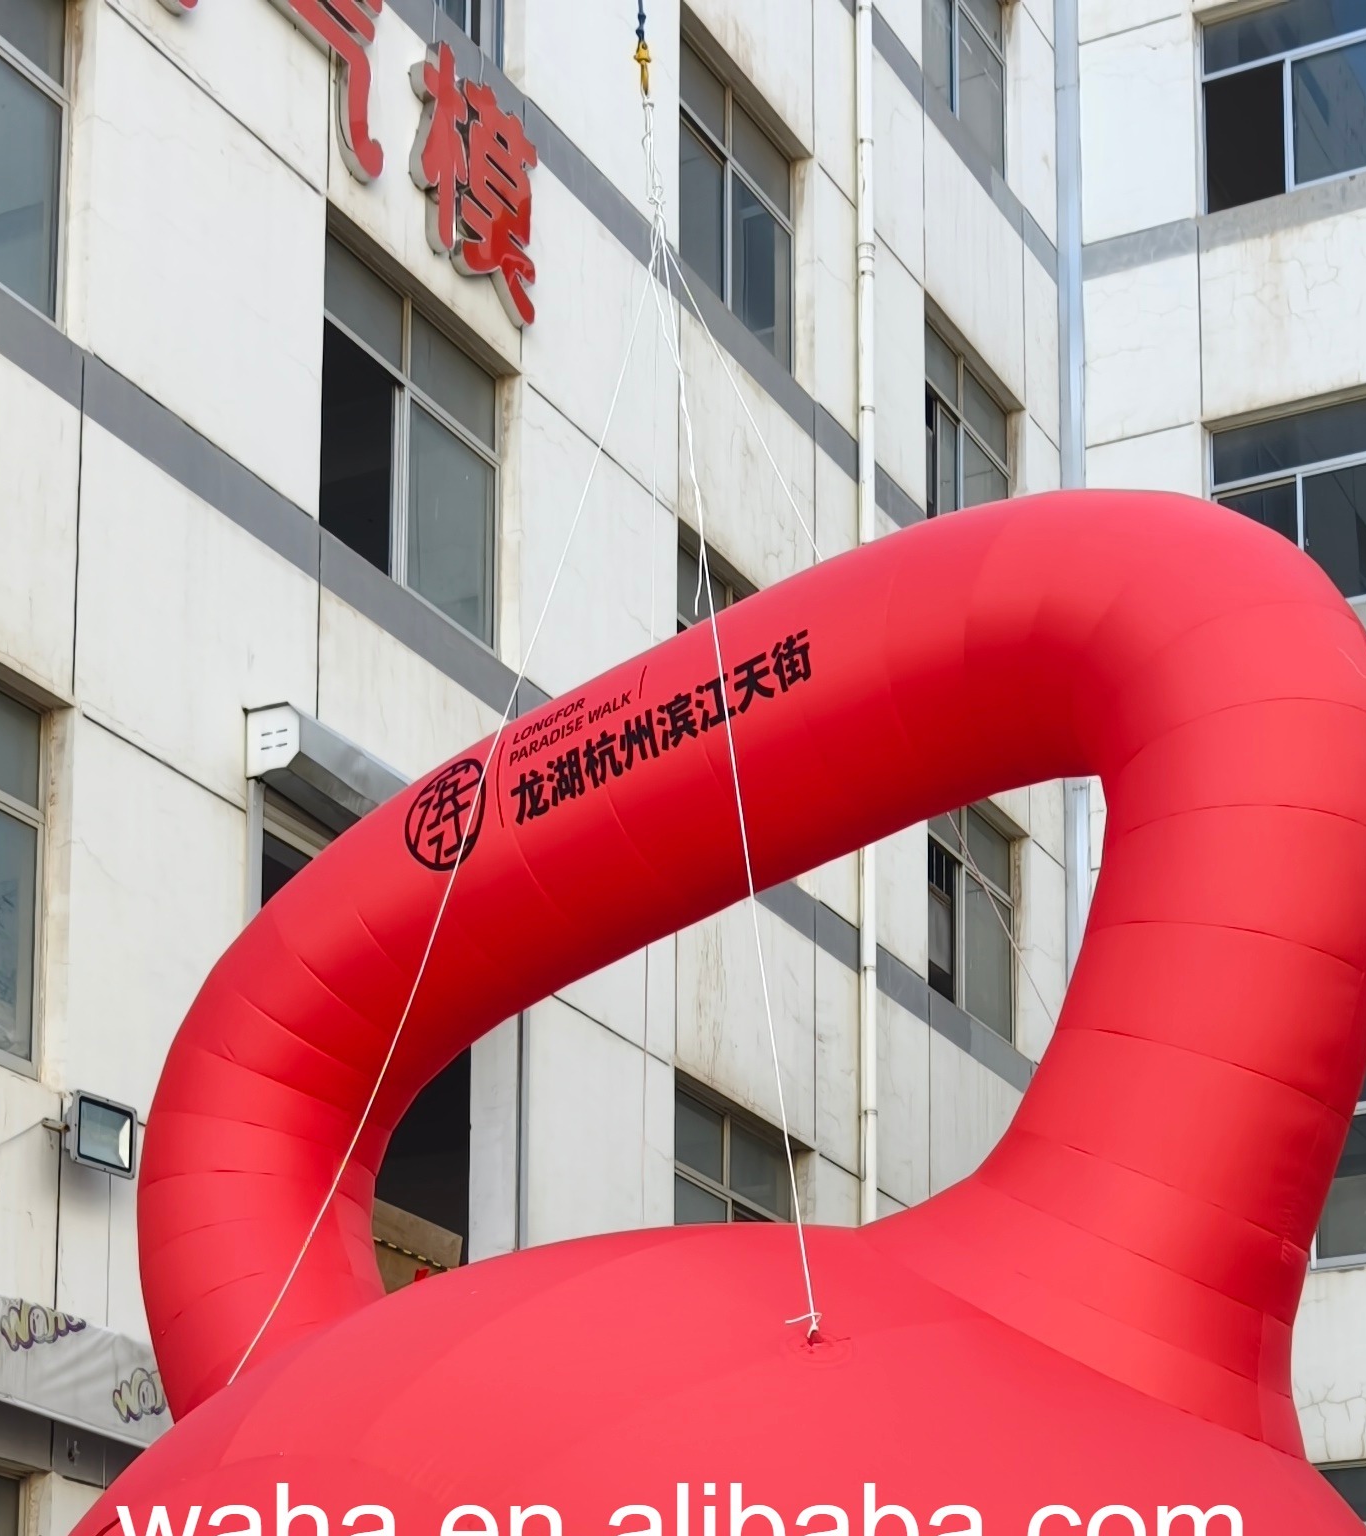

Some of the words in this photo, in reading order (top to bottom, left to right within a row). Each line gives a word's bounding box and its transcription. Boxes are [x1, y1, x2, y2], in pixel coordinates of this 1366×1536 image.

[508, 715, 584, 767] PARADISE
[588, 690, 633, 734] WALK
[510, 629, 813, 825] 龙湖杭州滨江天街
[512, 697, 587, 745] LONGFOR
